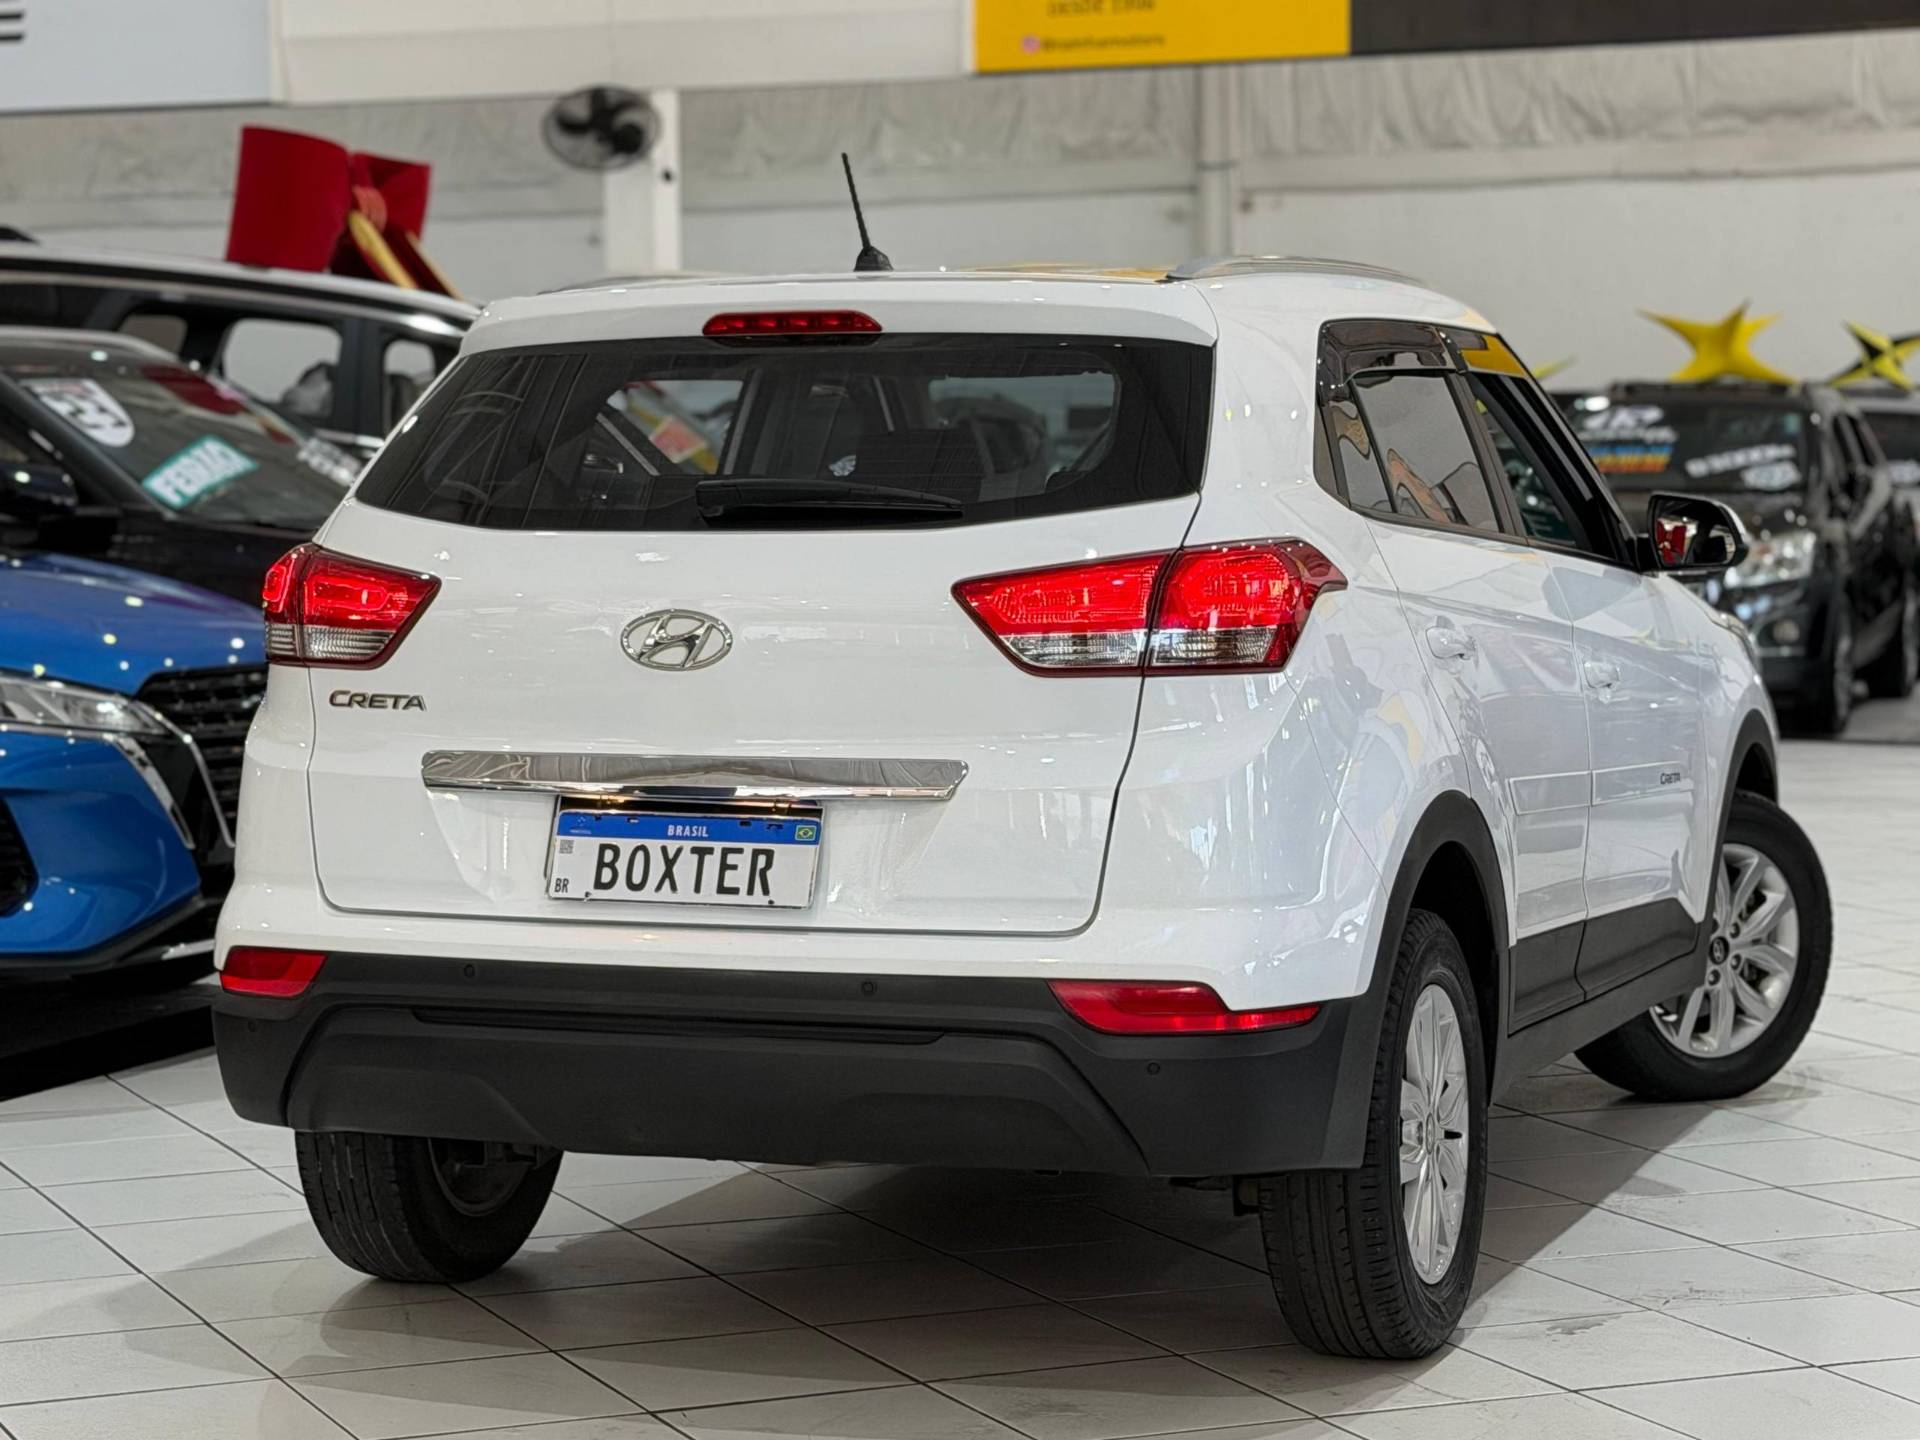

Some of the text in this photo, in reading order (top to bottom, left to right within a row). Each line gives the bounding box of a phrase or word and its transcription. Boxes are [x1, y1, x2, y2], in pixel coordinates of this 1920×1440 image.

[329, 690, 427, 711] CRETA
[667, 824, 709, 838] BRASIL
[593, 843, 775, 896] BOXTER
[554, 878, 569, 893] BR
